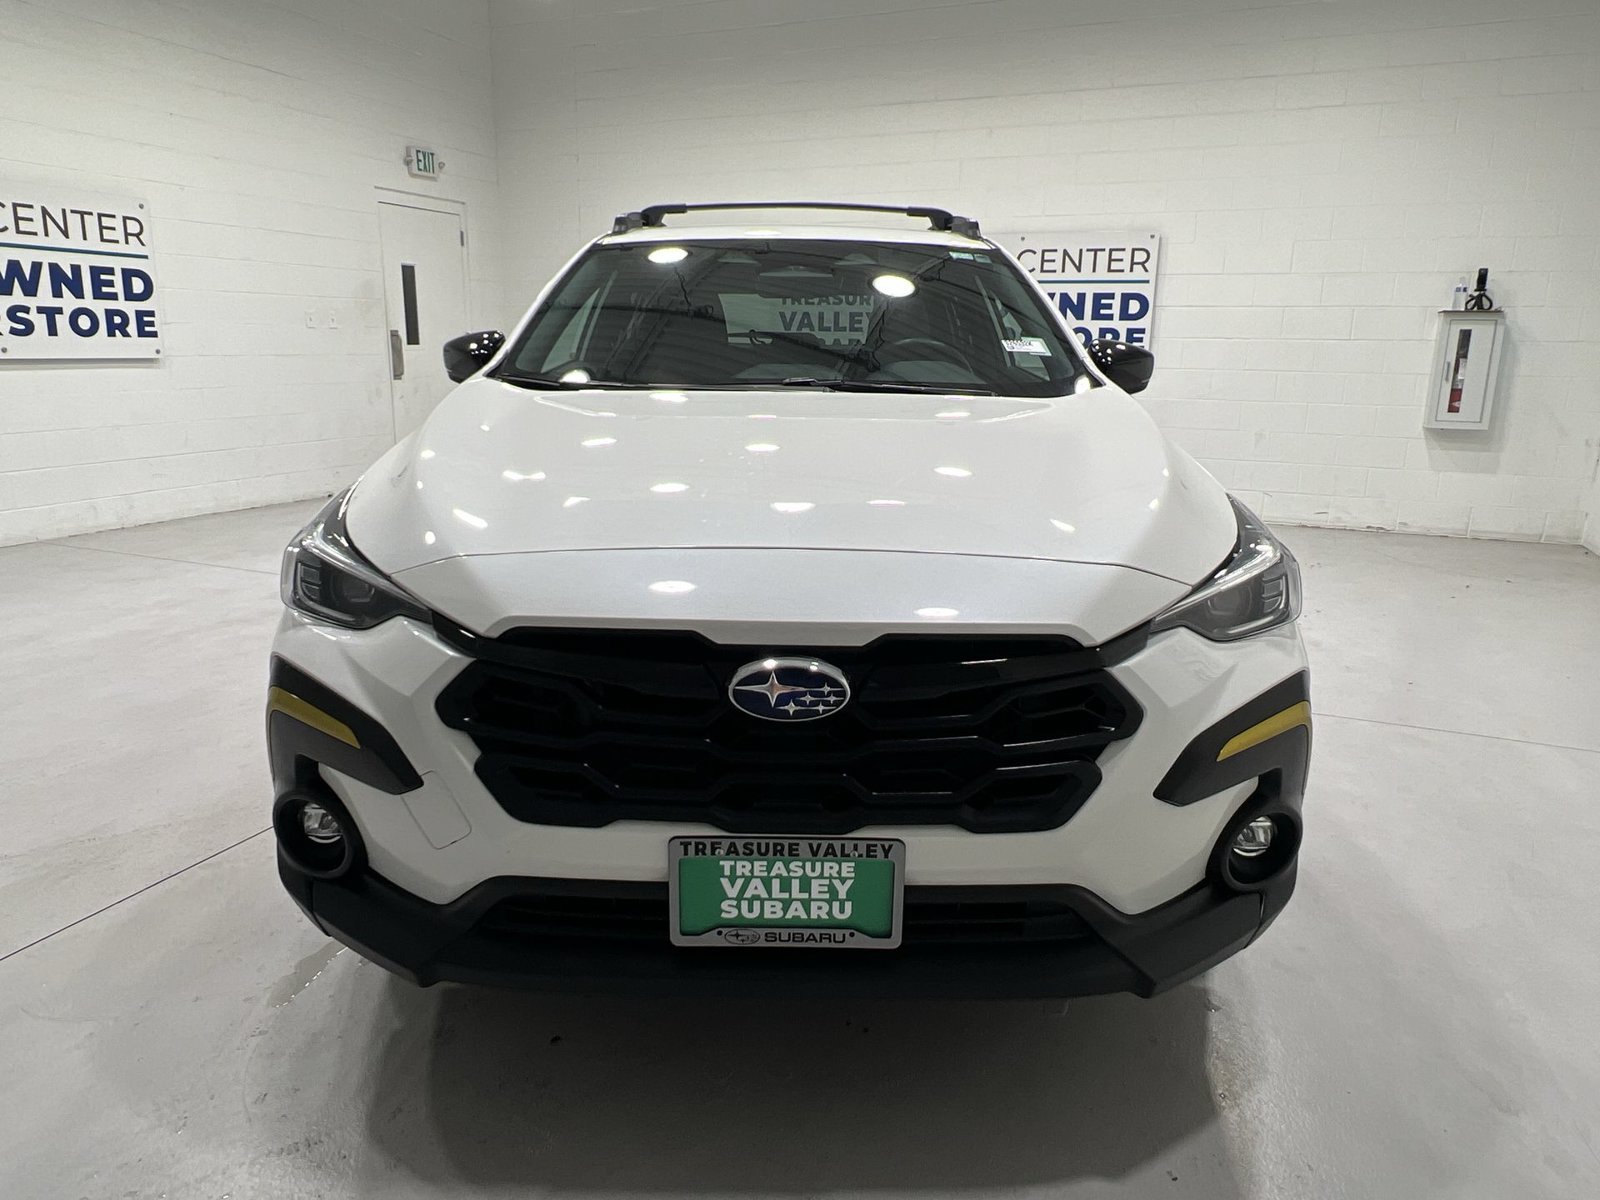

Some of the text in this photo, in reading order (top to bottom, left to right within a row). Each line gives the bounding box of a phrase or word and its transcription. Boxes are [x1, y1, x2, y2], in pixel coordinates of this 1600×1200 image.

[416, 149, 435, 174] EXIT
[1017, 247, 1151, 273] CENTER
[1047, 292, 1150, 321] NED
[0, 304, 158, 338] STORE
[680, 841, 894, 859] TREASURE VALLEY
[719, 860, 856, 878] TREASURE
[720, 877, 856, 900] VALLEY
[720, 899, 853, 920] SUBARU
[764, 931, 847, 945] SUBARU
